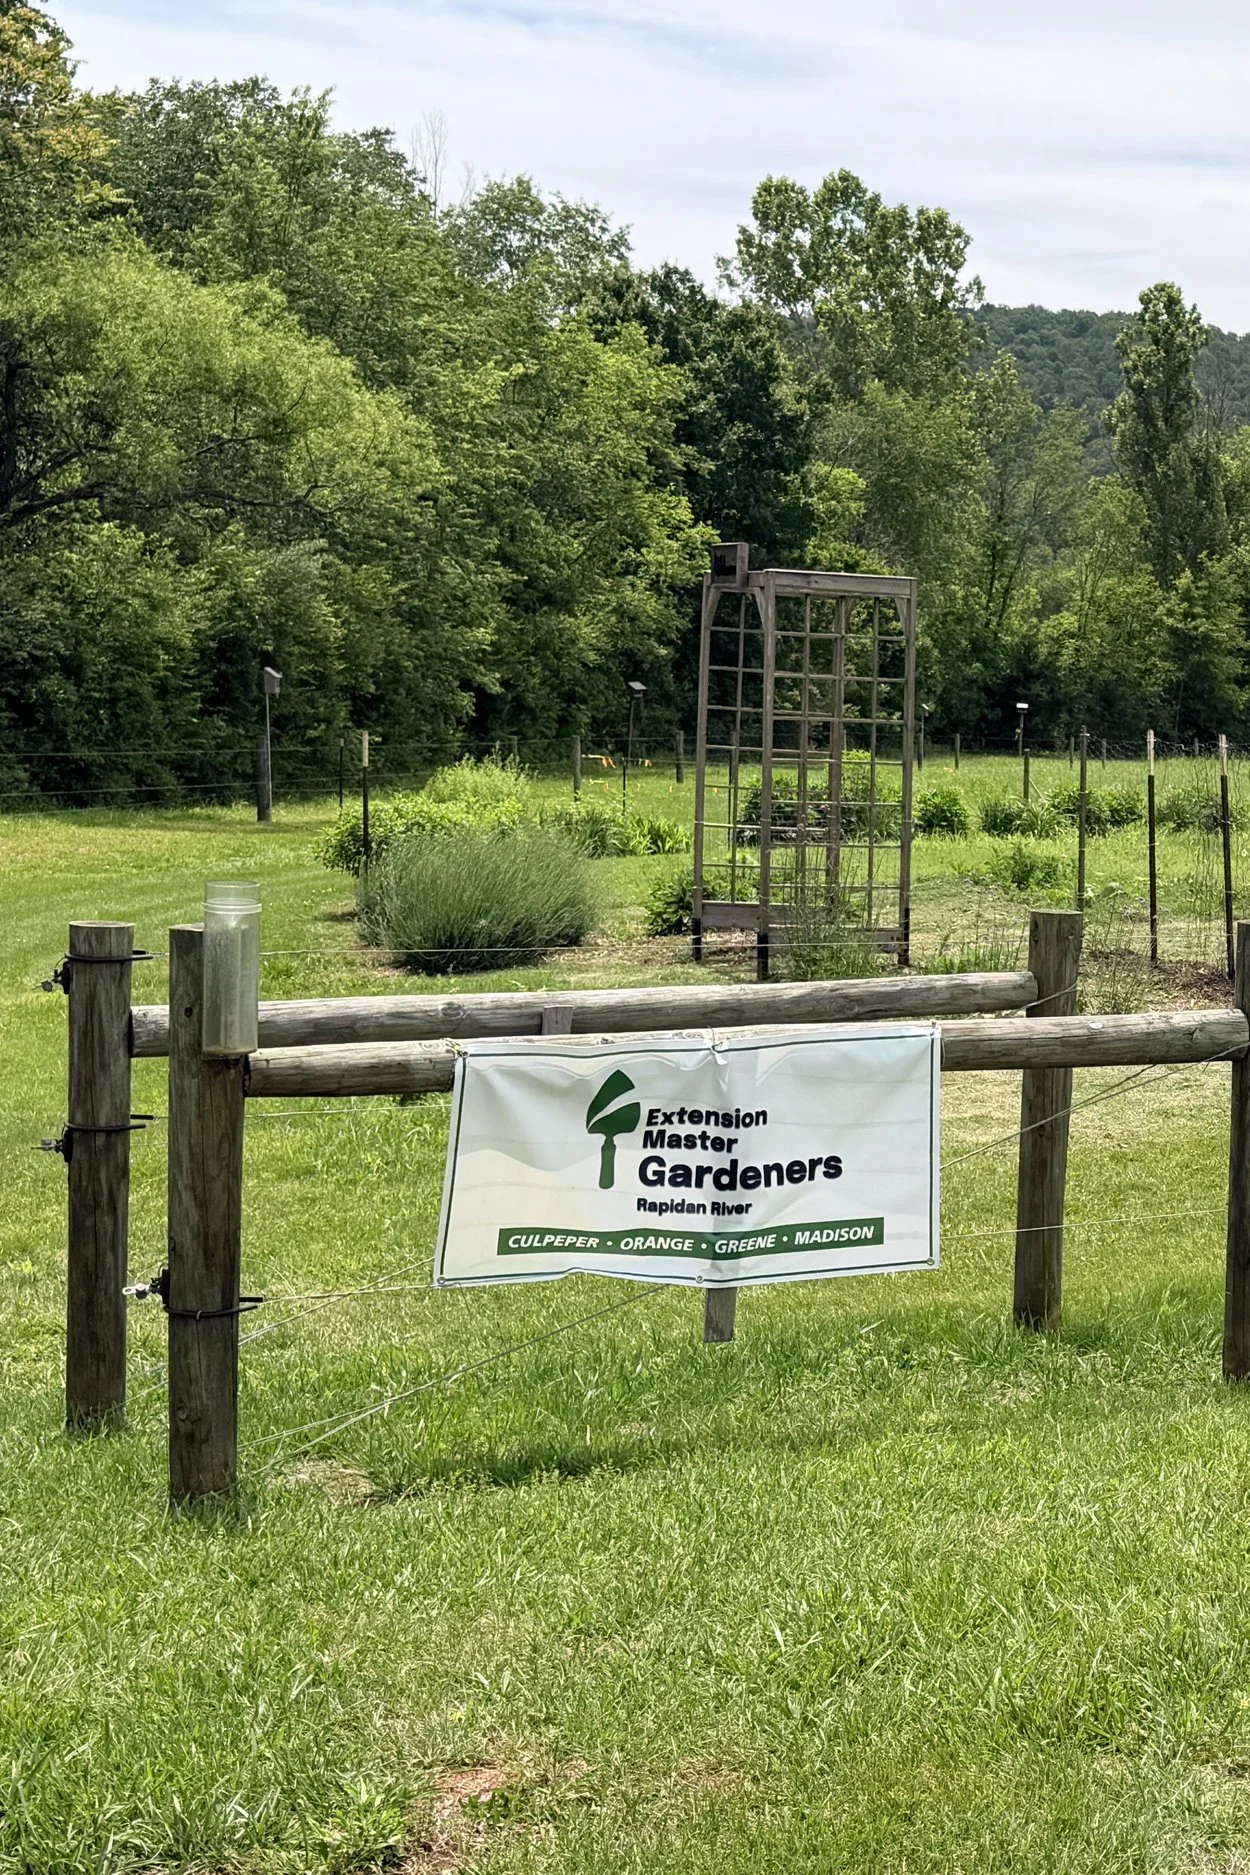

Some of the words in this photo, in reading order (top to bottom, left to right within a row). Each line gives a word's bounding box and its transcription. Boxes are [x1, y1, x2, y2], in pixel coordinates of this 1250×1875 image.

[646, 1107, 768, 1129] Extension
[642, 1129, 738, 1153] Master
[638, 1155, 843, 1191] Gardeners
[636, 1197, 707, 1216] Rapidan
[711, 1201, 752, 1216] River
[508, 1234, 600, 1249] CULPEPER
[620, 1236, 695, 1252] ORANGE
[714, 1234, 777, 1254] GREENE
[794, 1225, 875, 1246] MADISON
